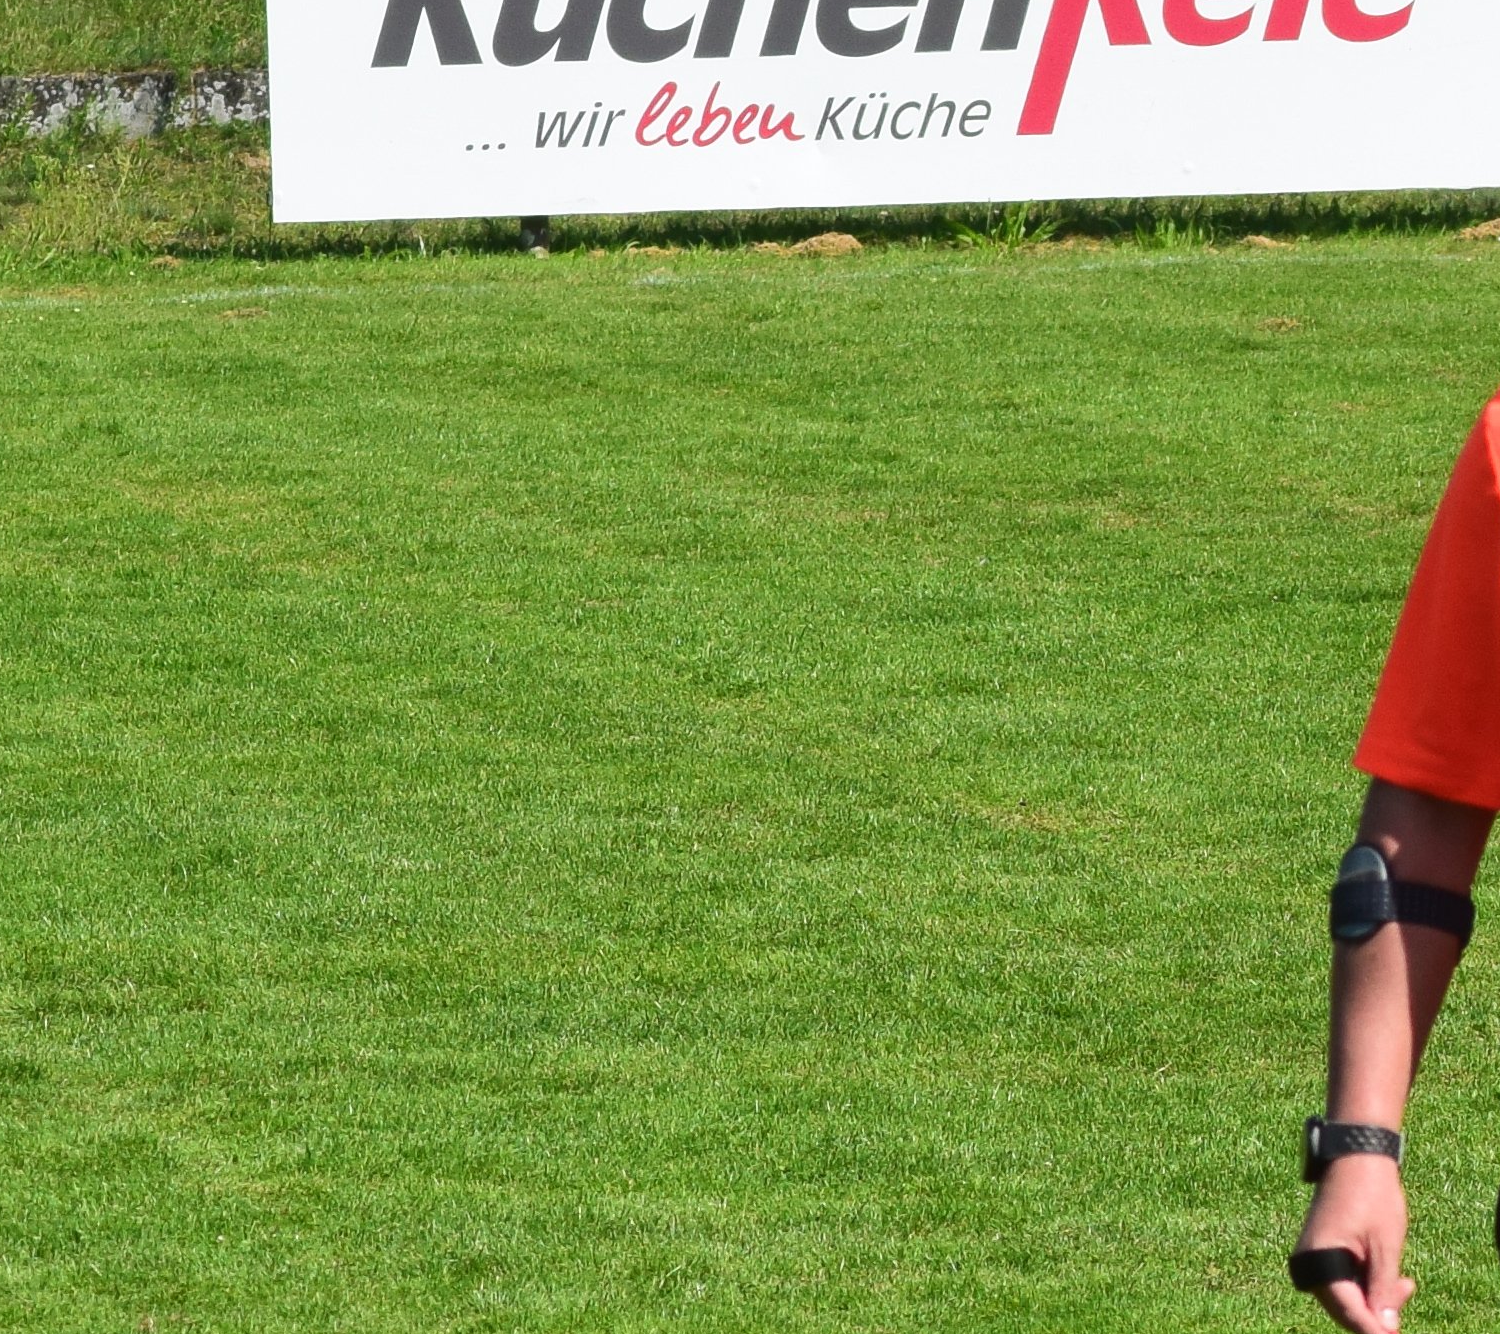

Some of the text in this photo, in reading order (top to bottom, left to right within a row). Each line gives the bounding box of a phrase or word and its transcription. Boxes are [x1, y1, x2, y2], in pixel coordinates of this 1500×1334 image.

[536, 102, 626, 148] wir
[636, 82, 803, 149] leben
[816, 93, 991, 141] Küche
